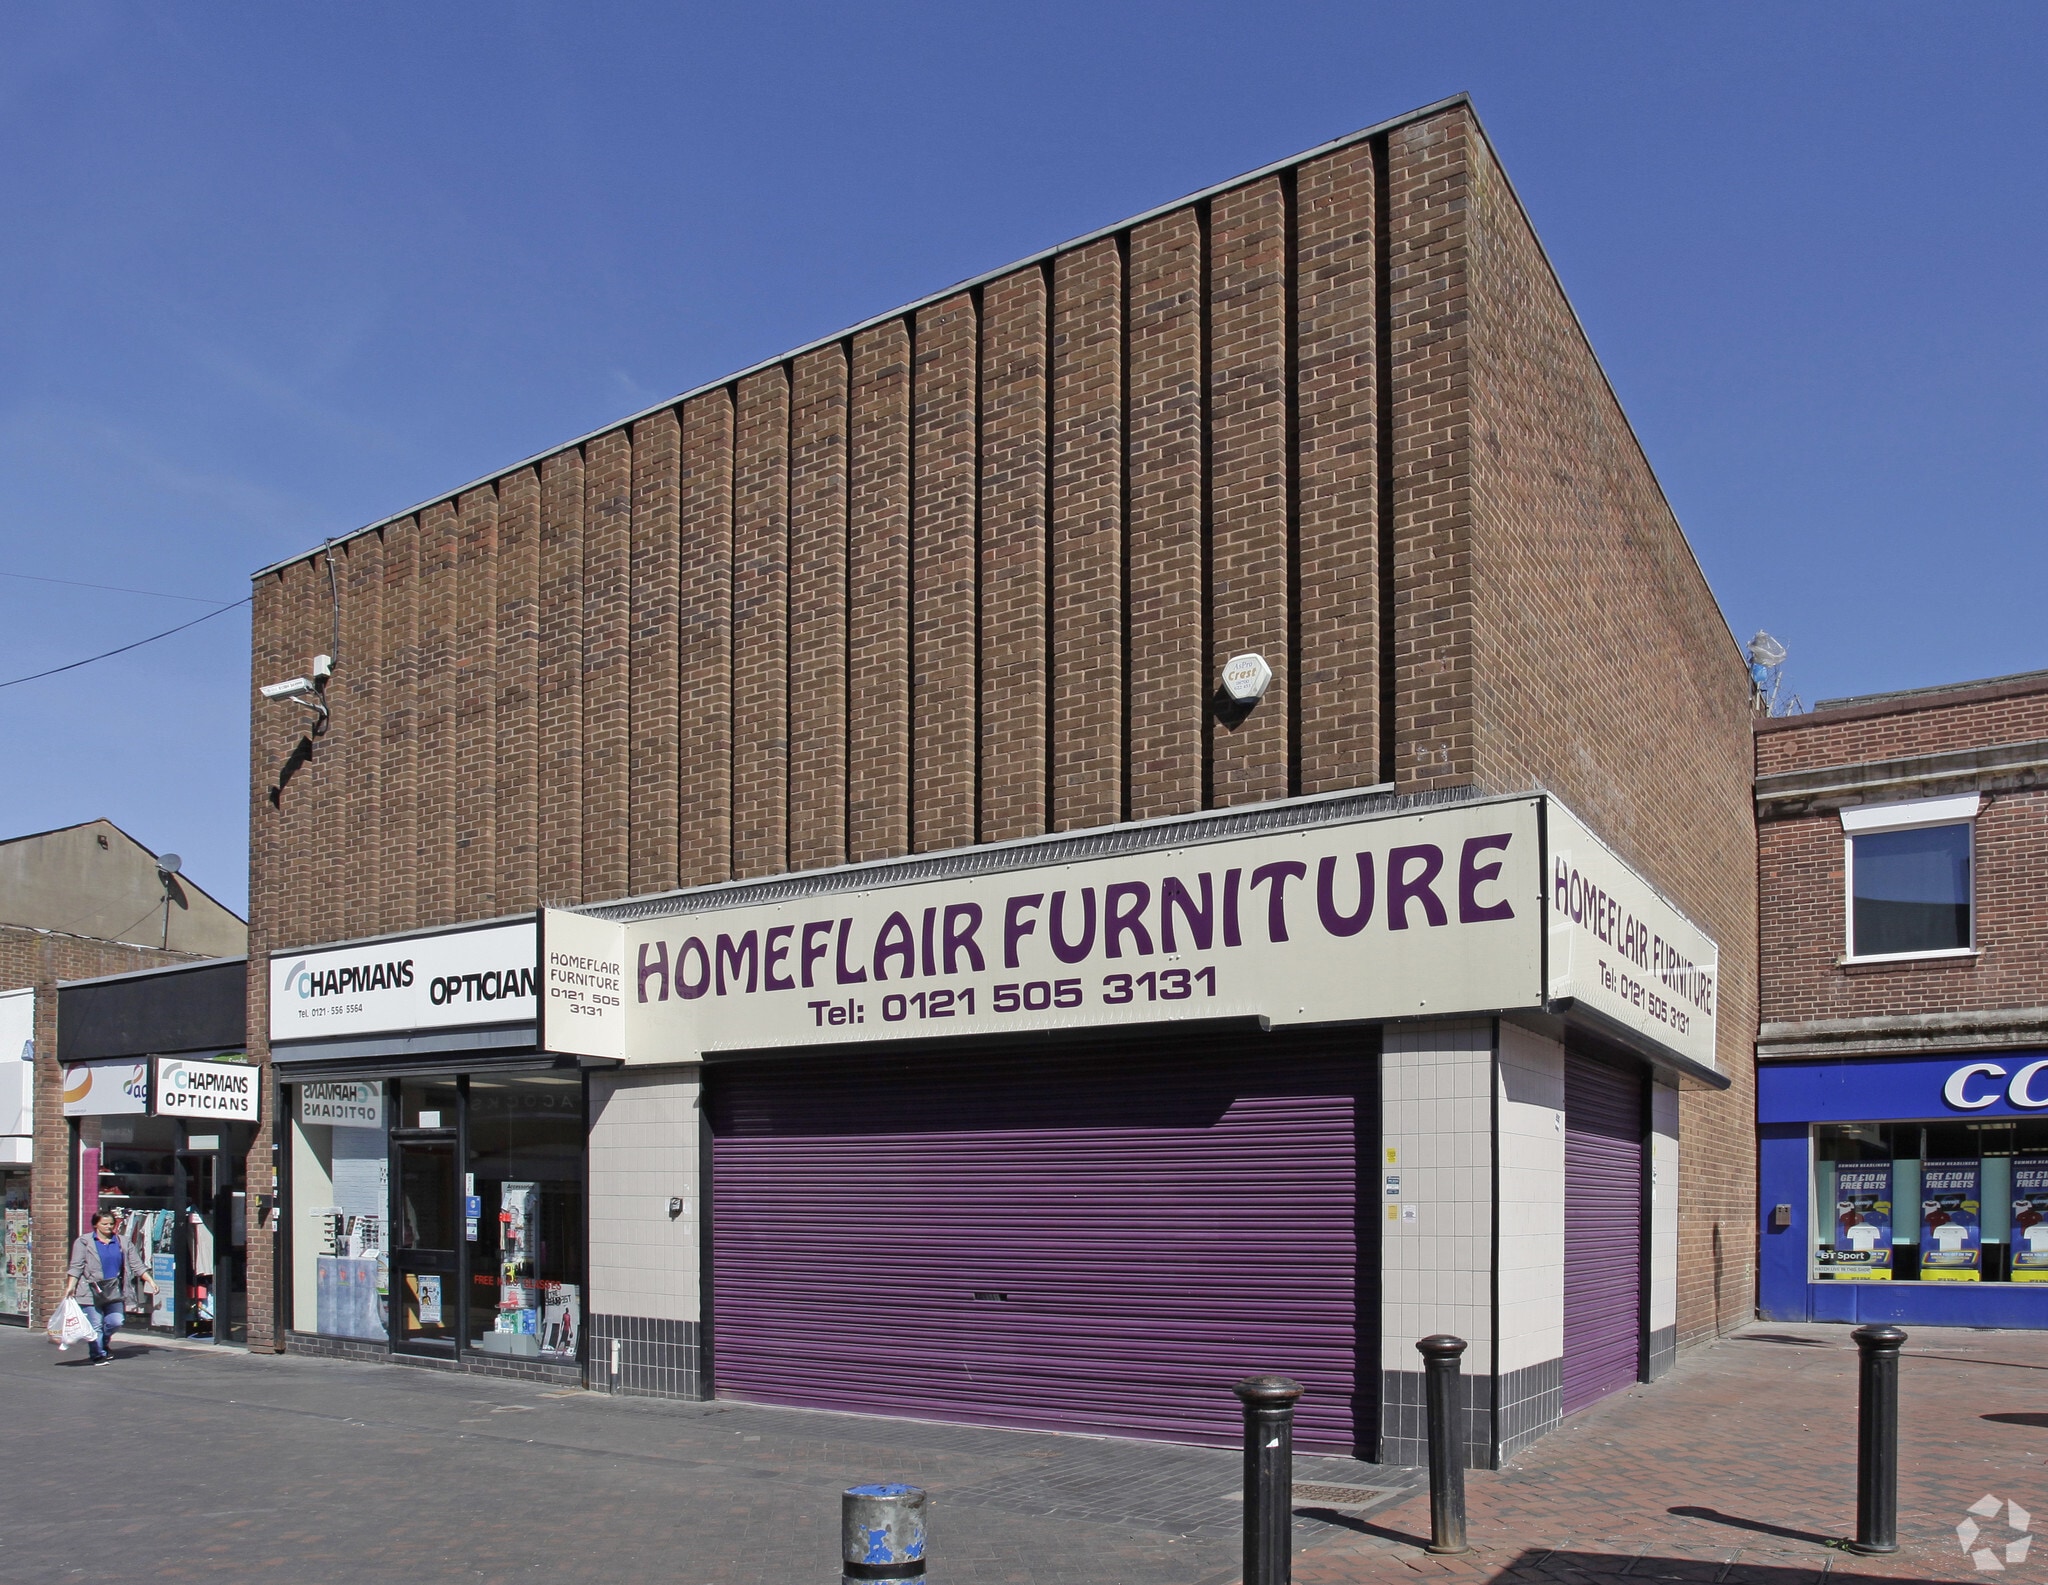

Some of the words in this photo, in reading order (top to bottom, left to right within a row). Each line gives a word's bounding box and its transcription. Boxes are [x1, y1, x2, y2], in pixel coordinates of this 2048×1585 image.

[1228, 667, 1257, 681] Crest
[638, 903, 985, 1003] HOMEFLAIR
[1004, 833, 1515, 968] FURNITURE
[1555, 856, 1648, 971] HOMEFLAIR
[1653, 934, 1712, 1016] FURNITURE
[550, 952, 620, 975] HOMEFLAIR
[299, 960, 414, 998] CHAPMANS
[550, 969, 620, 992] FURNITURE
[550, 988, 585, 1001] 0121
[593, 995, 620, 1006] 505
[808, 998, 865, 1026] Tel:
[882, 988, 976, 1022] 0121
[993, 978, 1083, 1013] 505
[1102, 966, 1217, 1004] 3131
[1599, 959, 1617, 993] Tel:
[1621, 974, 1646, 1010] 0121
[1648, 992, 1668, 1023] 505
[1670, 1006, 1690, 1036] 3131
[346, 1004, 363, 1013] 5564
[570, 1004, 603, 1017] 3131
[175, 1071, 248, 1094] CHAPMANS
[165, 1093, 248, 1112] OPTICIANS
[1840, 1174, 1858, 1182] GET
[1858, 1173, 1876, 1181] £10
[1876, 1173, 1887, 1181] IN
[1926, 1172, 1944, 1180] GET
[1945, 1172, 1963, 1180] £10
[1964, 1172, 1975, 1180] IN
[2016, 1171, 2035, 1179] GET
[2036, 1170, 2048, 1179] £1
[1840, 1182, 1862, 1190] FREE
[1863, 1181, 1886, 1189] BETS
[1926, 1180, 1949, 1188] FREE
[1950, 1180, 1974, 1188] BETS
[2016, 1179, 2040, 1188] FREE
[1837, 1252, 1865, 1261] Sport
[474, 1275, 494, 1286] FREE
[522, 1278, 562, 1291] GLASSES
